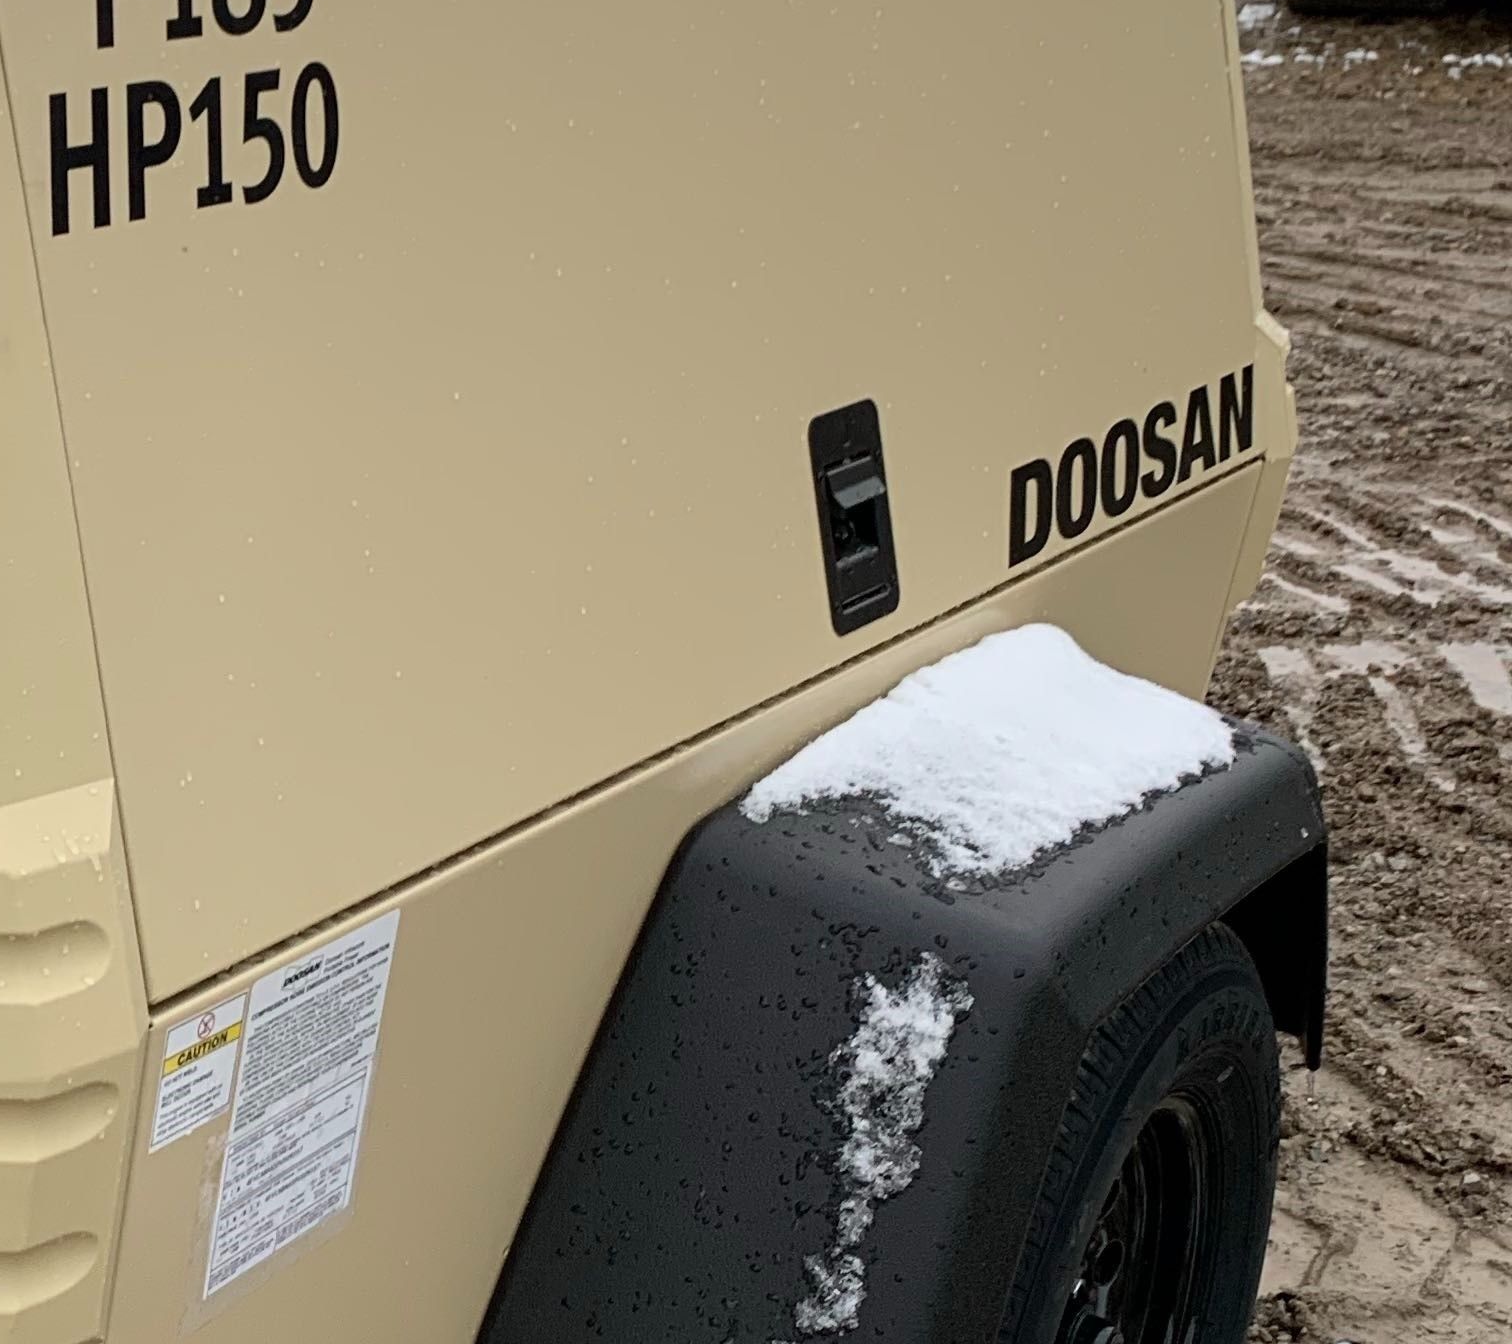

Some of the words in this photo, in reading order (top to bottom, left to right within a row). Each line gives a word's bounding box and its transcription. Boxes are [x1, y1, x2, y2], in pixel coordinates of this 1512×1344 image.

[49, 61, 339, 237] HP150
[1007, 363, 1254, 569] DOOSAN
[177, 1032, 228, 1066] CAUTION
